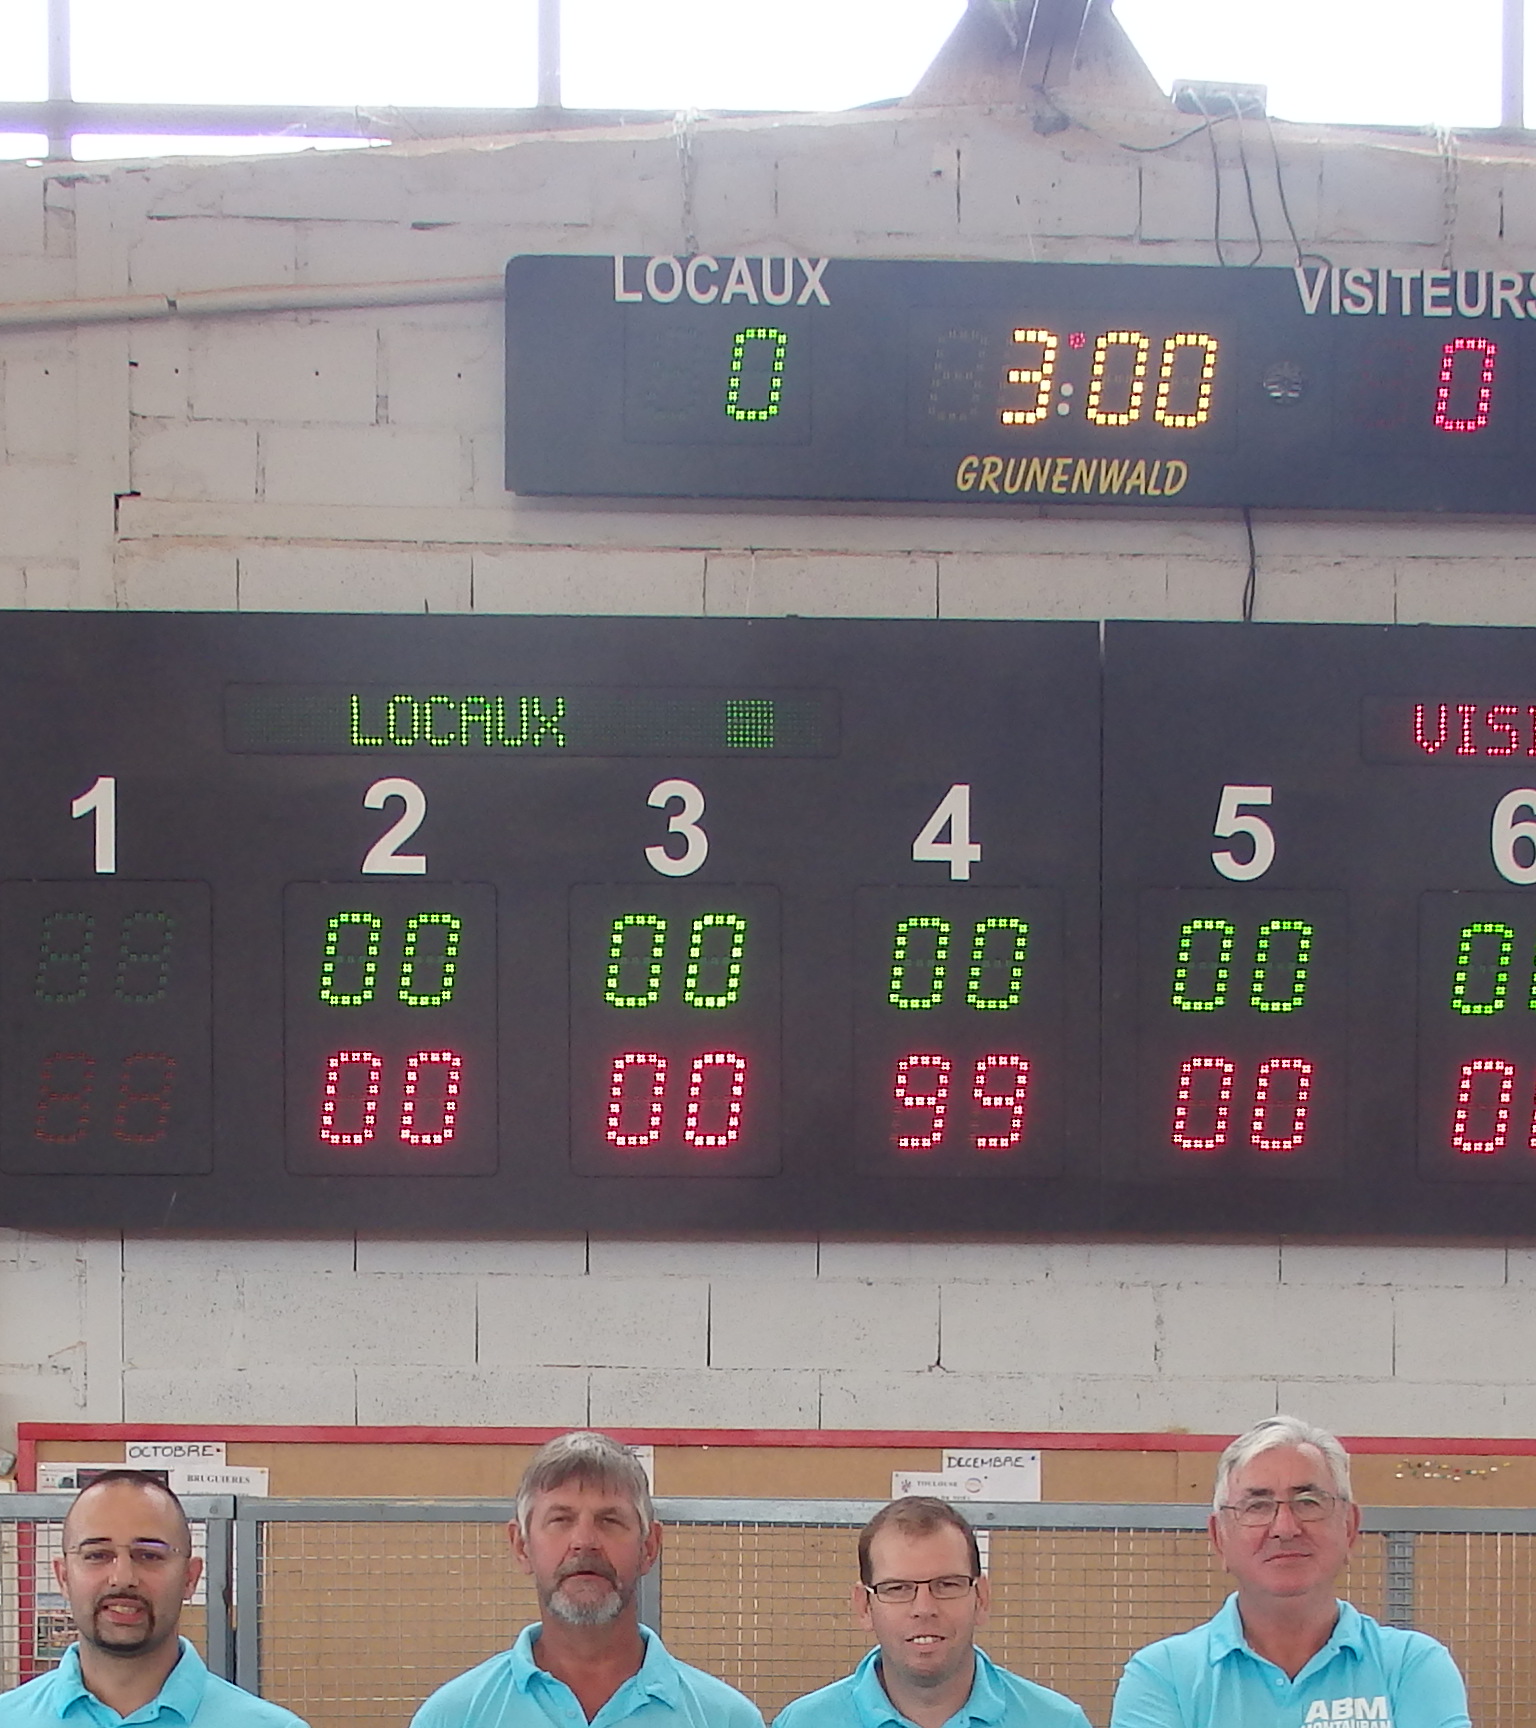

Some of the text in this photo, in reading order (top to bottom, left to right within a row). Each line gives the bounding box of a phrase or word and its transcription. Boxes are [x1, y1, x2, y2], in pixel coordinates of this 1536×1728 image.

[611, 255, 832, 306] LOCAUX
[726, 327, 785, 423] 0
[1000, 328, 1220, 428] 3:00
[1432, 337, 1496, 433] 0
[954, 456, 1190, 498] GRUNENWALD
[350, 693, 566, 748] LOCAUX
[69, 777, 117, 875] 1
[361, 778, 428, 875] 2
[645, 779, 710, 877] 3
[912, 784, 982, 881] 4
[1210, 785, 1275, 881] 5
[320, 911, 464, 1007] 00
[605, 913, 748, 1009] 00
[889, 915, 1029, 1010] 00
[1171, 918, 1314, 1012] 00
[319, 1049, 464, 1147] 00
[605, 1051, 748, 1148] 00
[892, 1053, 1030, 1150] 99
[1171, 1056, 1314, 1152] 00
[128, 1444, 215, 1459] OCTOBRE
[946, 1456, 1025, 1469] DECEMBRE
[1304, 1696, 1389, 1723] ABM
